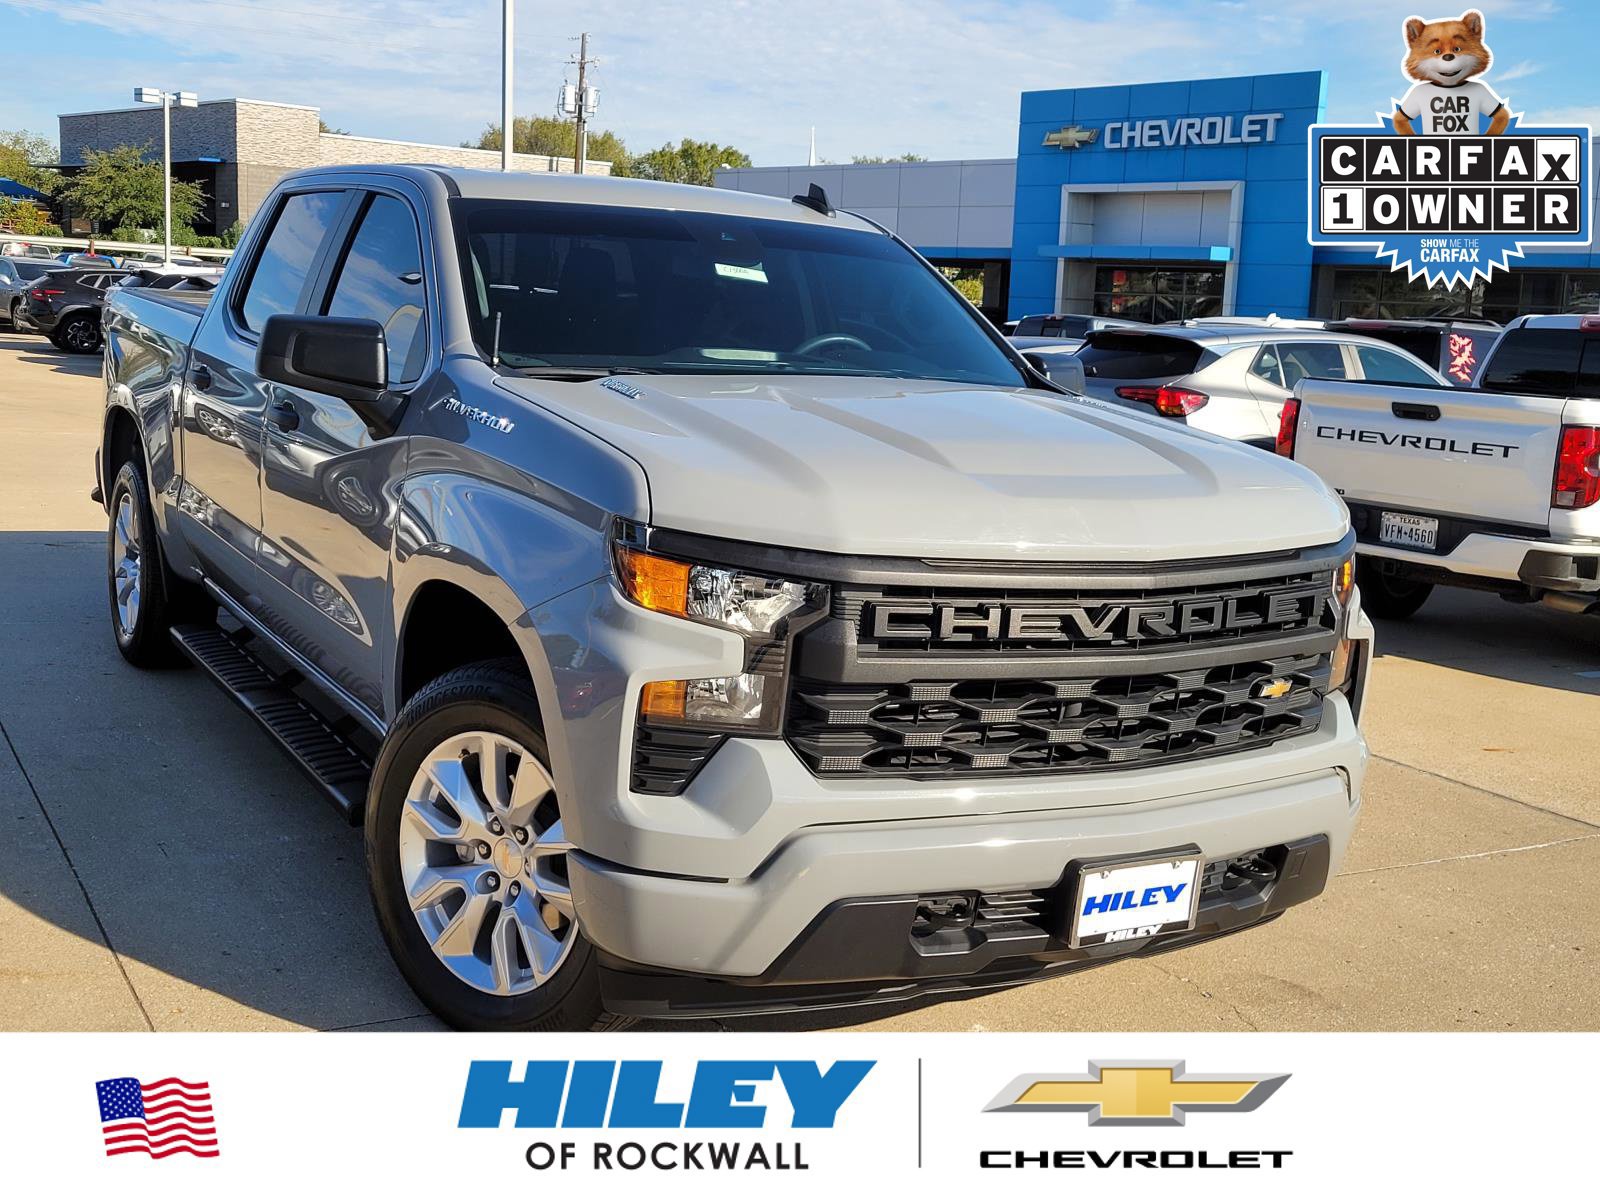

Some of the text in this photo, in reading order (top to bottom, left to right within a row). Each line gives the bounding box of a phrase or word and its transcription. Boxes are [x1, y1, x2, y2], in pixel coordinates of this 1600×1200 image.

[1104, 113, 1284, 149] CHEVROLET
[1317, 426, 1519, 459] CHEVROLET
[1400, 516, 1421, 526] TEXAS
[869, 585, 1330, 641] CHEVROLET
[1082, 882, 1188, 917] HILEY
[1104, 923, 1164, 943] HILEY
